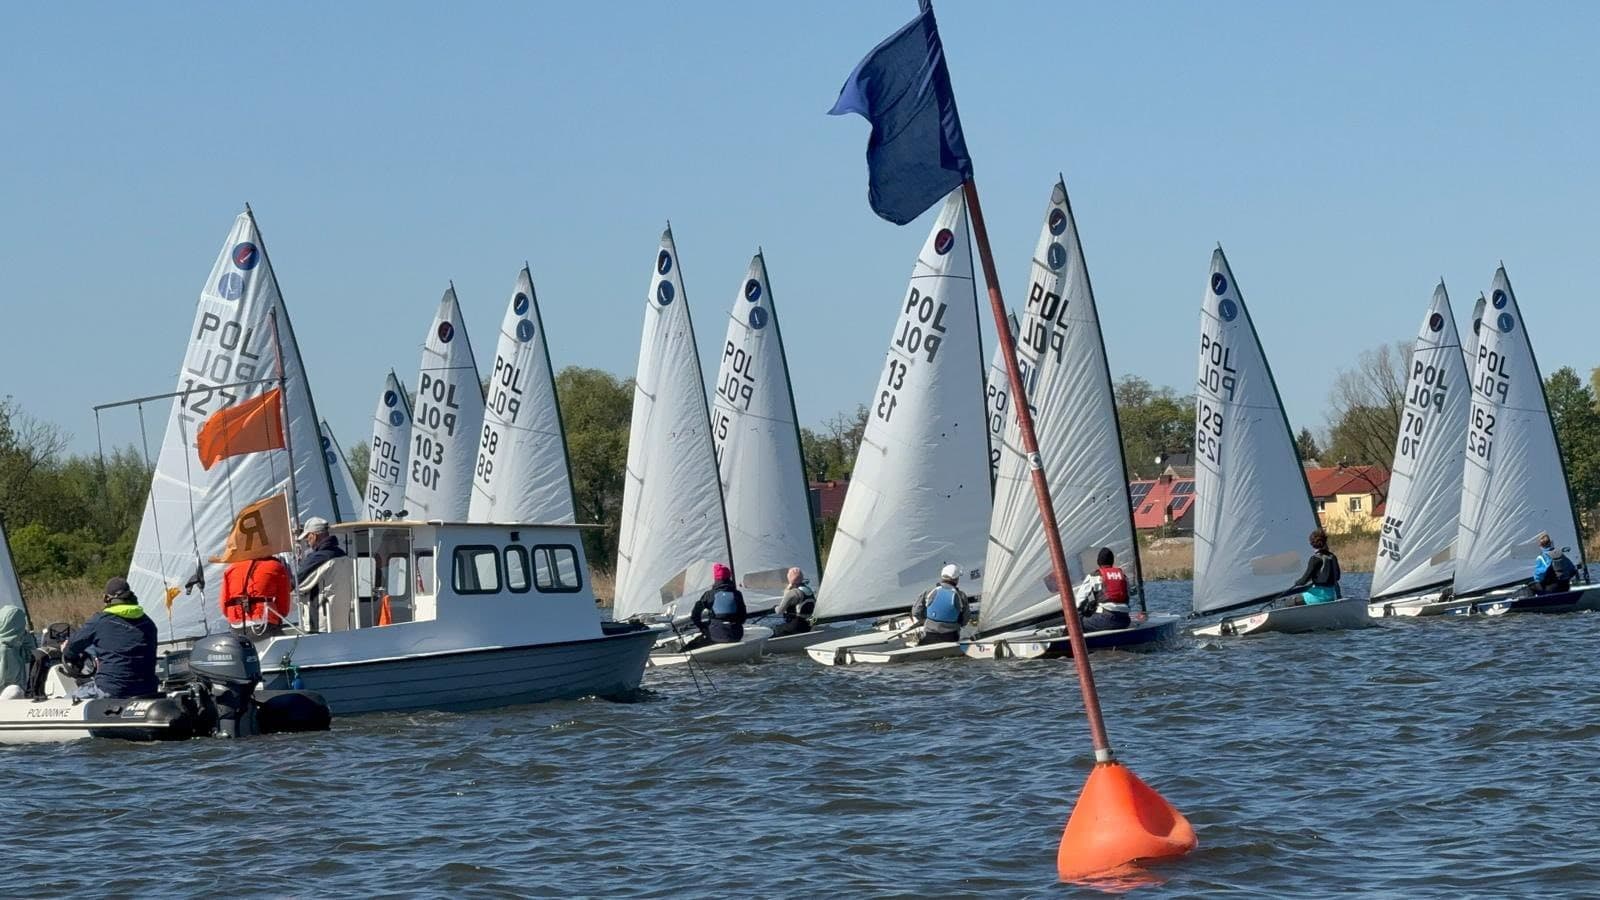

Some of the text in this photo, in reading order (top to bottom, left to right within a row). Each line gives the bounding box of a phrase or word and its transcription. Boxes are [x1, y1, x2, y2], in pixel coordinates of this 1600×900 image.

[905, 287, 947, 334] POL
[1028, 282, 1069, 330] POL
[196, 312, 259, 360] POL
[723, 340, 755, 382] POL
[1201, 333, 1236, 374] POL
[1478, 345, 1510, 379] POL
[420, 373, 459, 409] POL
[494, 355, 523, 395] POL
[888, 359, 907, 391] 13
[1414, 360, 1447, 391] POL
[988, 384, 1008, 414] PO
[1199, 400, 1223, 437] 129
[1405, 412, 1422, 437] 70
[1471, 408, 1496, 437] 162
[373, 436, 400, 464] POL
[415, 434, 444, 465] 103
[481, 424, 498, 456] 98
[369, 483, 389, 506] 187
[1106, 571, 1122, 580] HH
